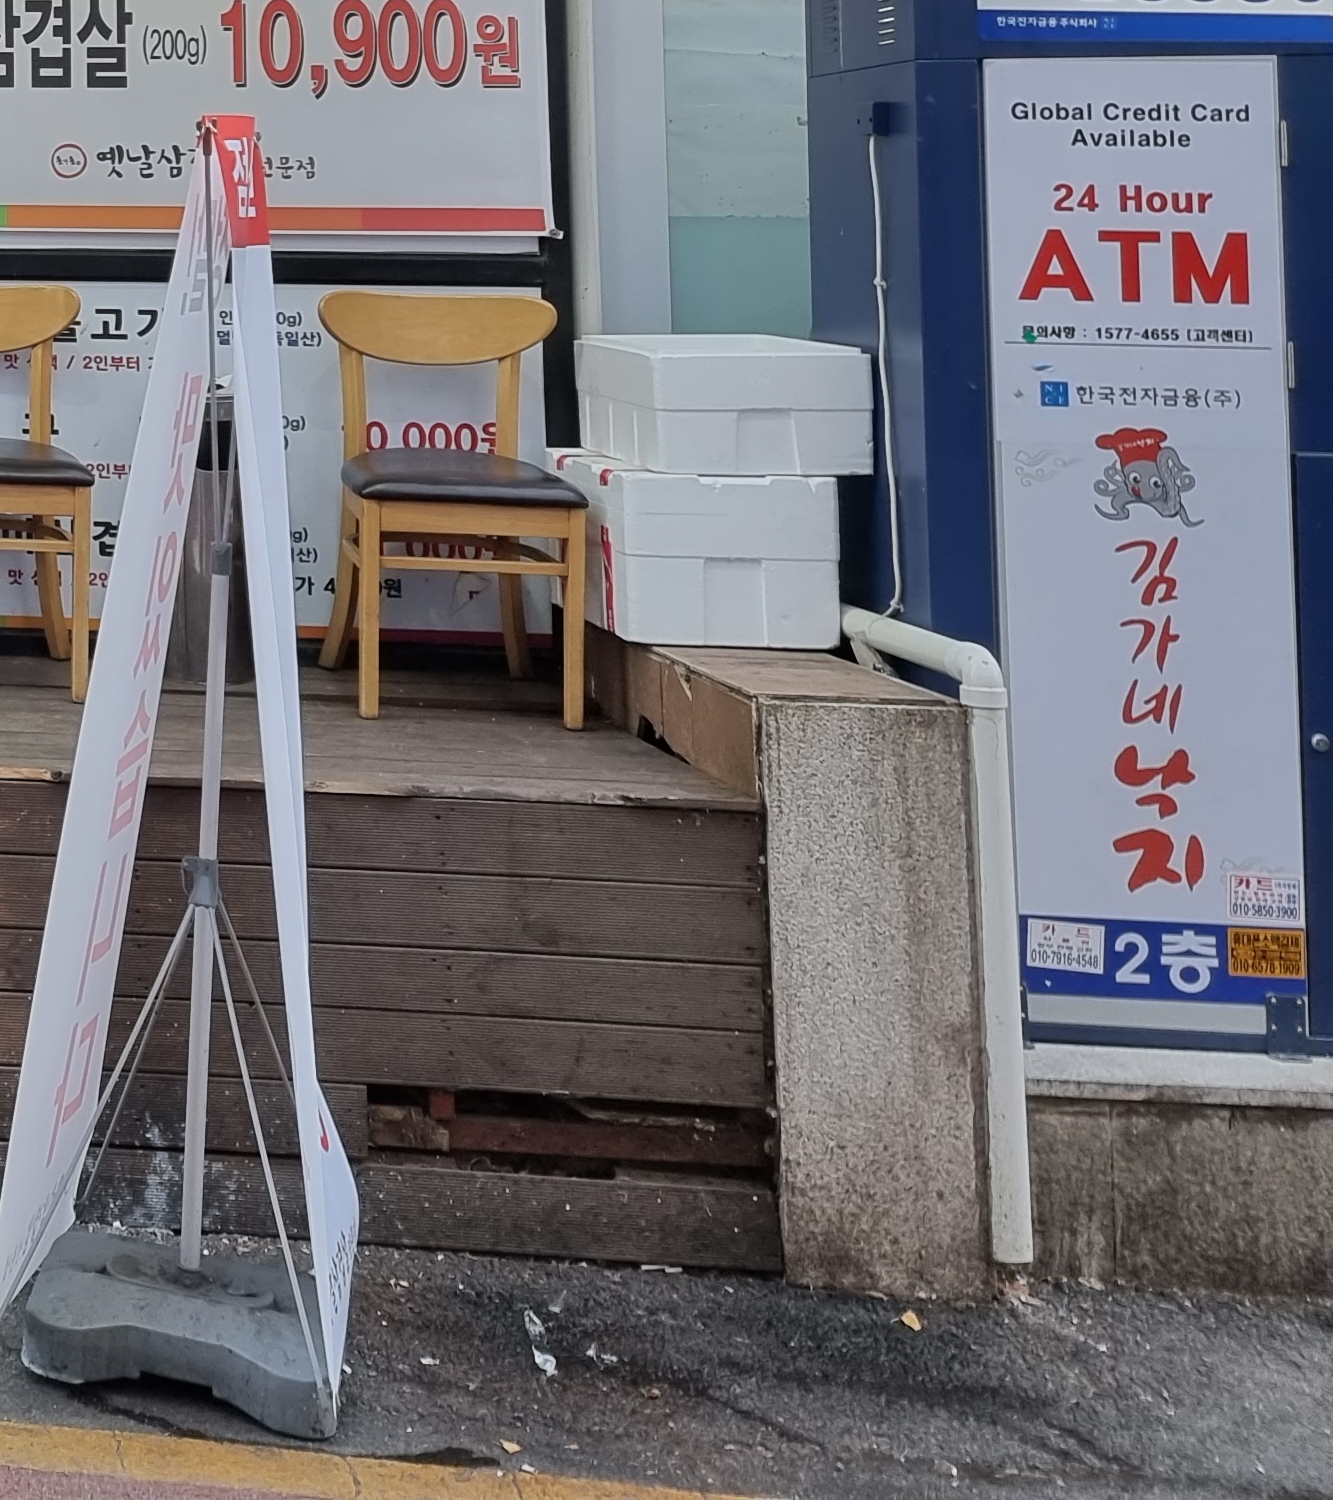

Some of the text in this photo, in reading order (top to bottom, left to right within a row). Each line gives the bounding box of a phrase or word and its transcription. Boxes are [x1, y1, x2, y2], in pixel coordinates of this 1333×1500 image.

[996, 16, 1097, 29] 한국전자금융 주식회사
[143, 24, 208, 66] (200g)
[1010, 102, 1251, 123] Global Credit Card
[1070, 128, 1191, 148] Available
[96, 145, 197, 178] 옛날삼
[1051, 183, 1213, 213] 24 Hour
[1018, 229, 1250, 304] ATM
[1096, 327, 1180, 341] 1577-4655
[5, 354, 20, 369] 맛
[83, 356, 141, 373] 2인부터
[1076, 385, 1241, 409] 한국전자금융(주)
[8, 567, 23, 583] 맛
[1113, 536, 1205, 892] 김가네낙지
